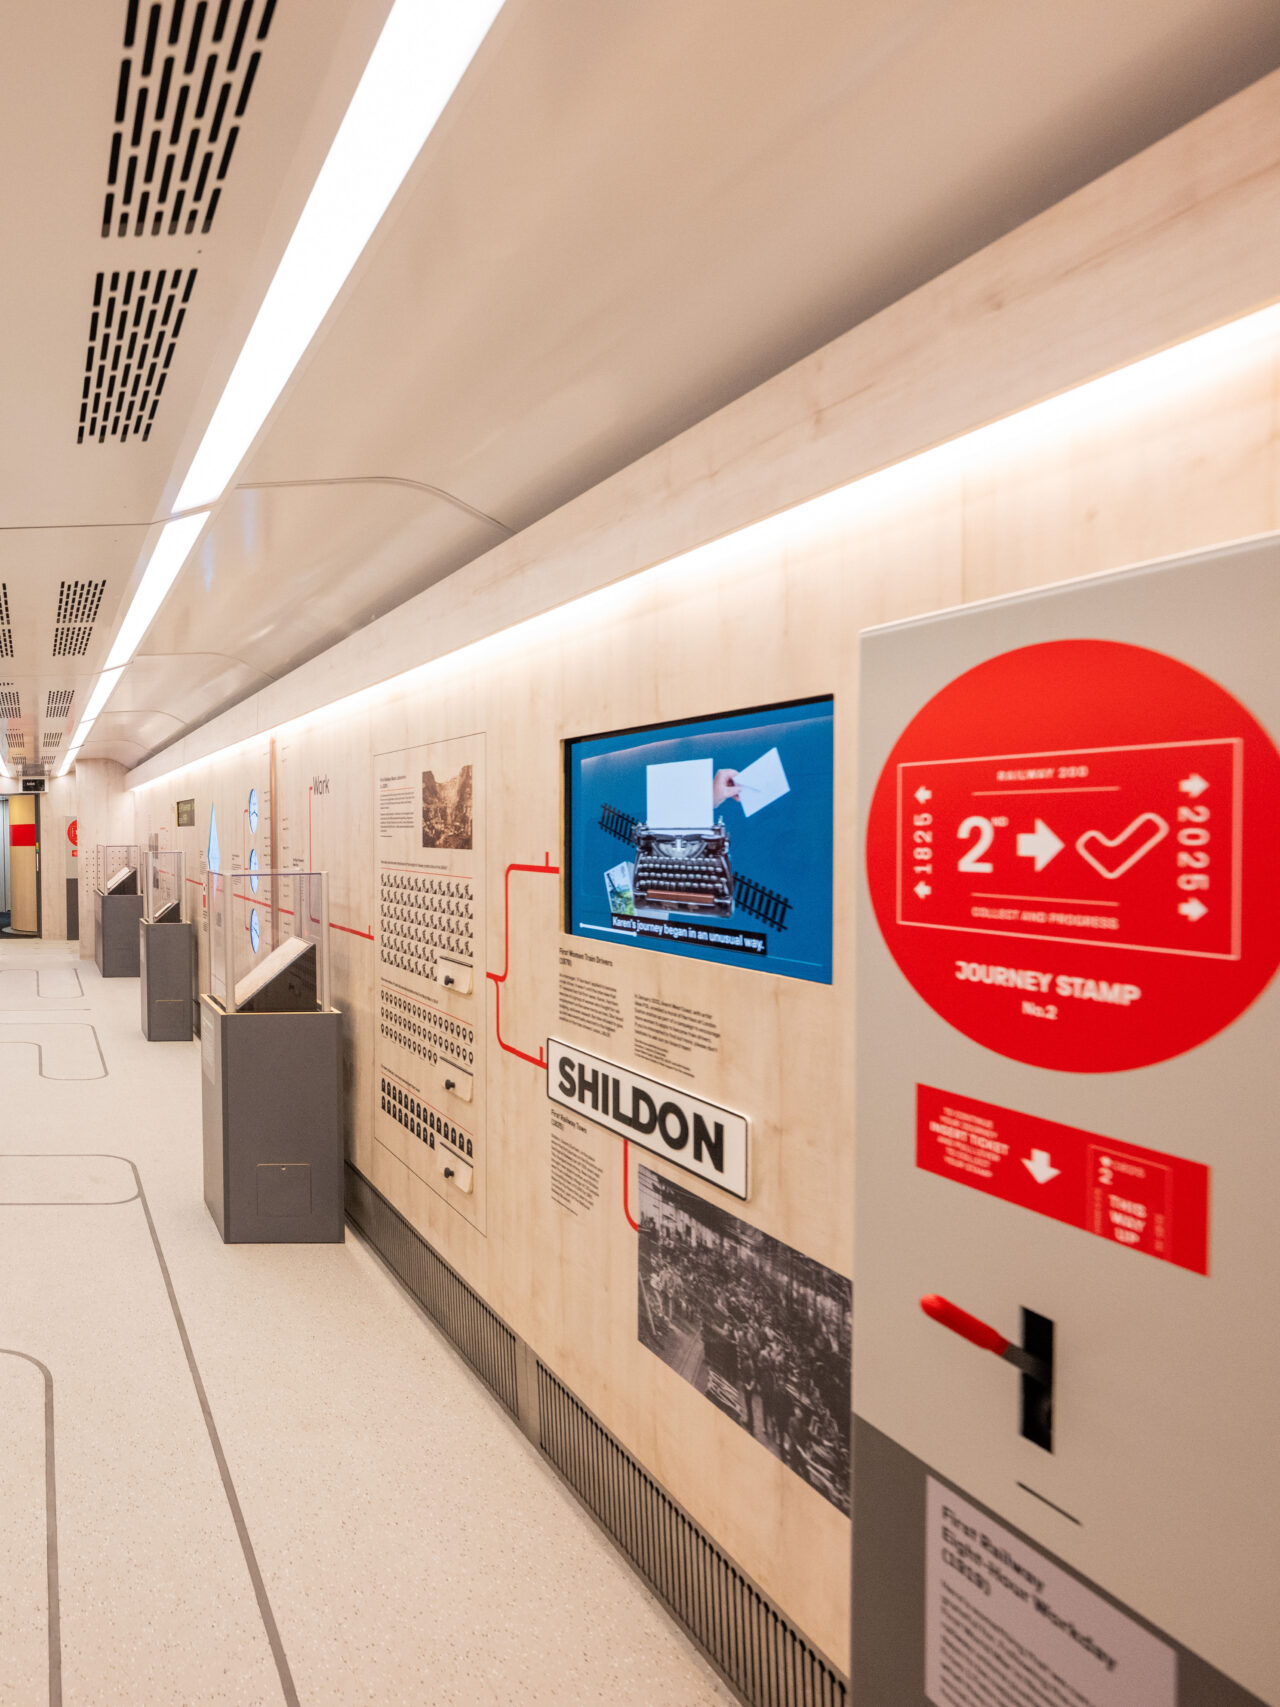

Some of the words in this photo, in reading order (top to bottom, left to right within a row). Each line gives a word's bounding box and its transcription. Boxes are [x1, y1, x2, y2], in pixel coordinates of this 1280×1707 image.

[312, 774, 330, 796] Work
[996, 766, 1054, 782] RAILWAY
[1057, 765, 1089, 779] 200
[913, 812, 933, 875] 1825
[1177, 805, 1210, 891] 2025
[612, 917, 637, 930] Karen's
[637, 920, 663, 935] journey
[664, 924, 688, 939] began
[688, 927, 697, 939] in
[698, 930, 709, 940] an
[709, 933, 744, 946] unusual
[744, 937, 765, 952] way.
[971, 906, 1021, 921] COLLECT
[1022, 911, 1046, 923] AND
[1048, 912, 1120, 931] PROGRESS
[954, 960, 1053, 994] JOURNEY
[1055, 974, 1142, 1007] STAMP
[1021, 1000, 1058, 1020] No.2
[558, 1056, 724, 1174] SHILDON
[941, 1504, 978, 1541] First
[979, 1531, 1045, 1594] Railway
[1031, 1593, 1117, 1673] Workday
